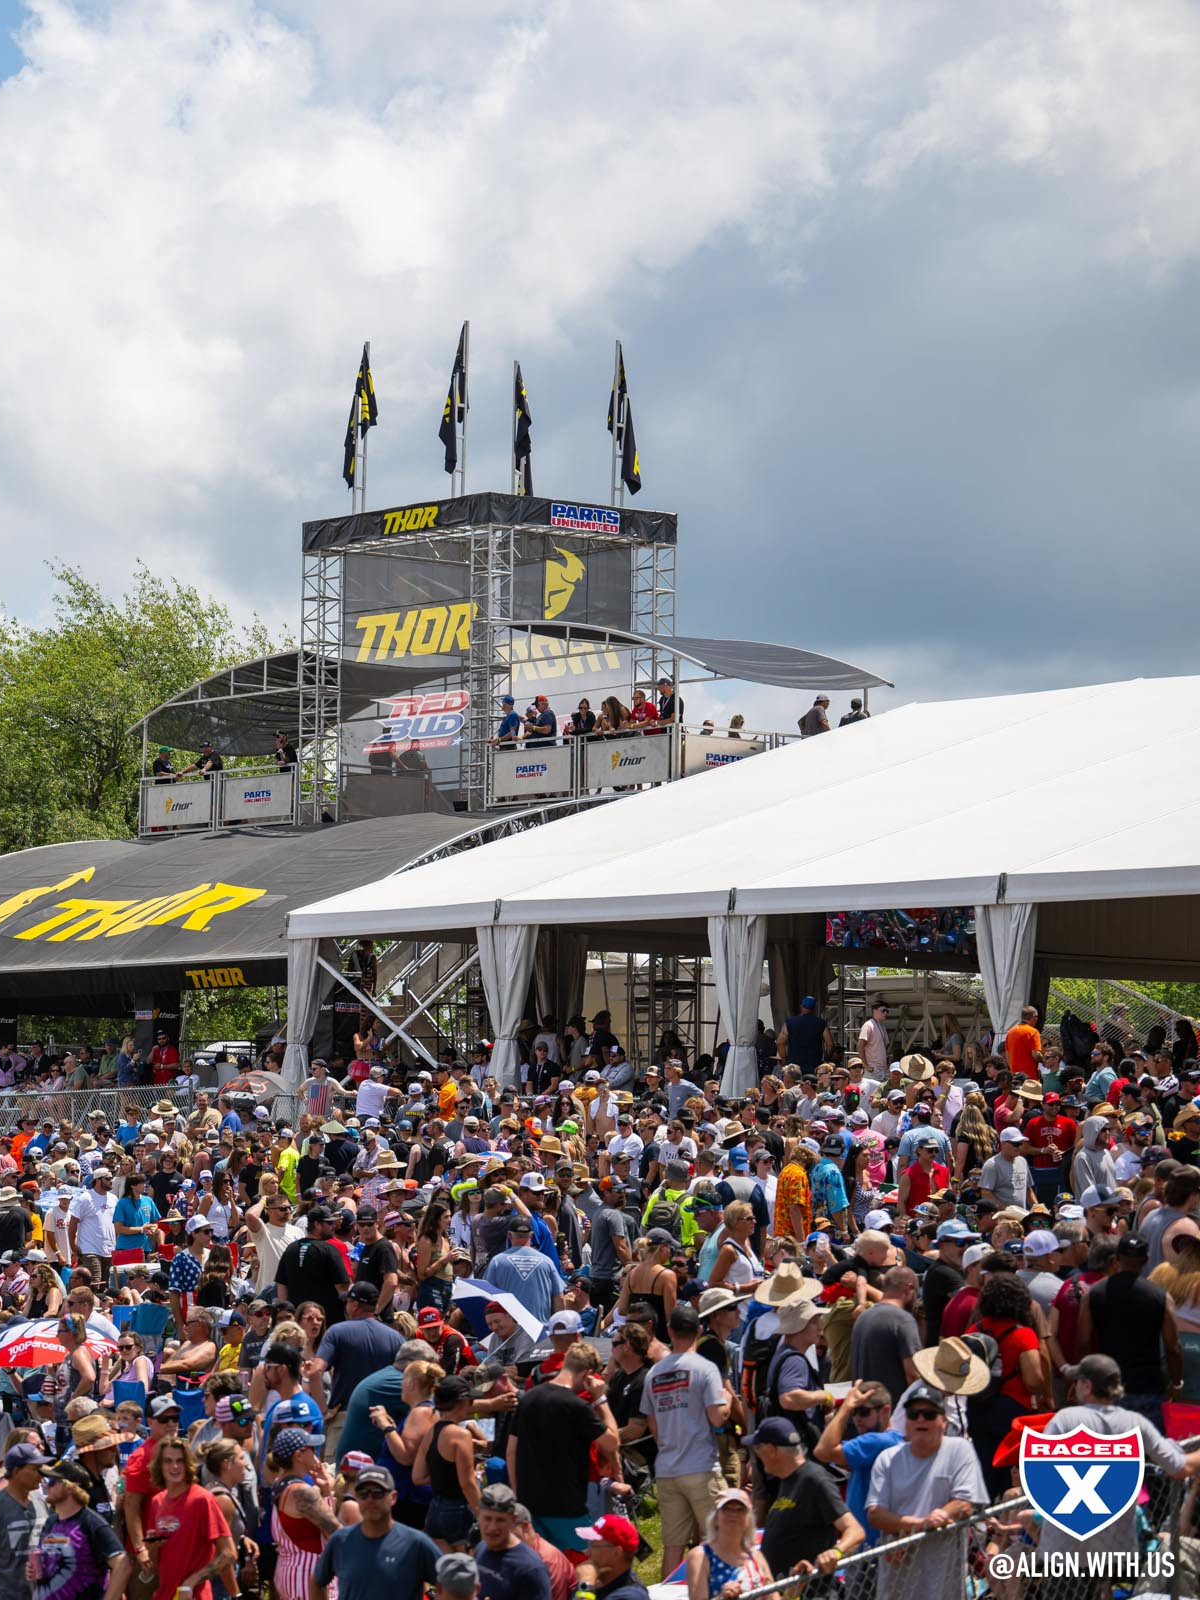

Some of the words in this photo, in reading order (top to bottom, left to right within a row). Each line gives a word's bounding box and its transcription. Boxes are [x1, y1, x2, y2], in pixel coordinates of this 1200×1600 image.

[383, 506, 438, 535] THOR
[551, 503, 619, 524] PARTS
[551, 517, 619, 534] UNLIMITED
[355, 602, 479, 662] THOR
[369, 690, 470, 719] RED
[369, 712, 465, 743] BUD
[516, 764, 547, 773] PARTS
[619, 756, 646, 767] thor
[244, 789, 271, 798] PARTS
[171, 801, 192, 811] thor
[13, 882, 267, 941] THOR
[185, 967, 249, 988] THOR
[8, 1340, 66, 1356] 100Percent
[298, 1402, 310, 1415] 3
